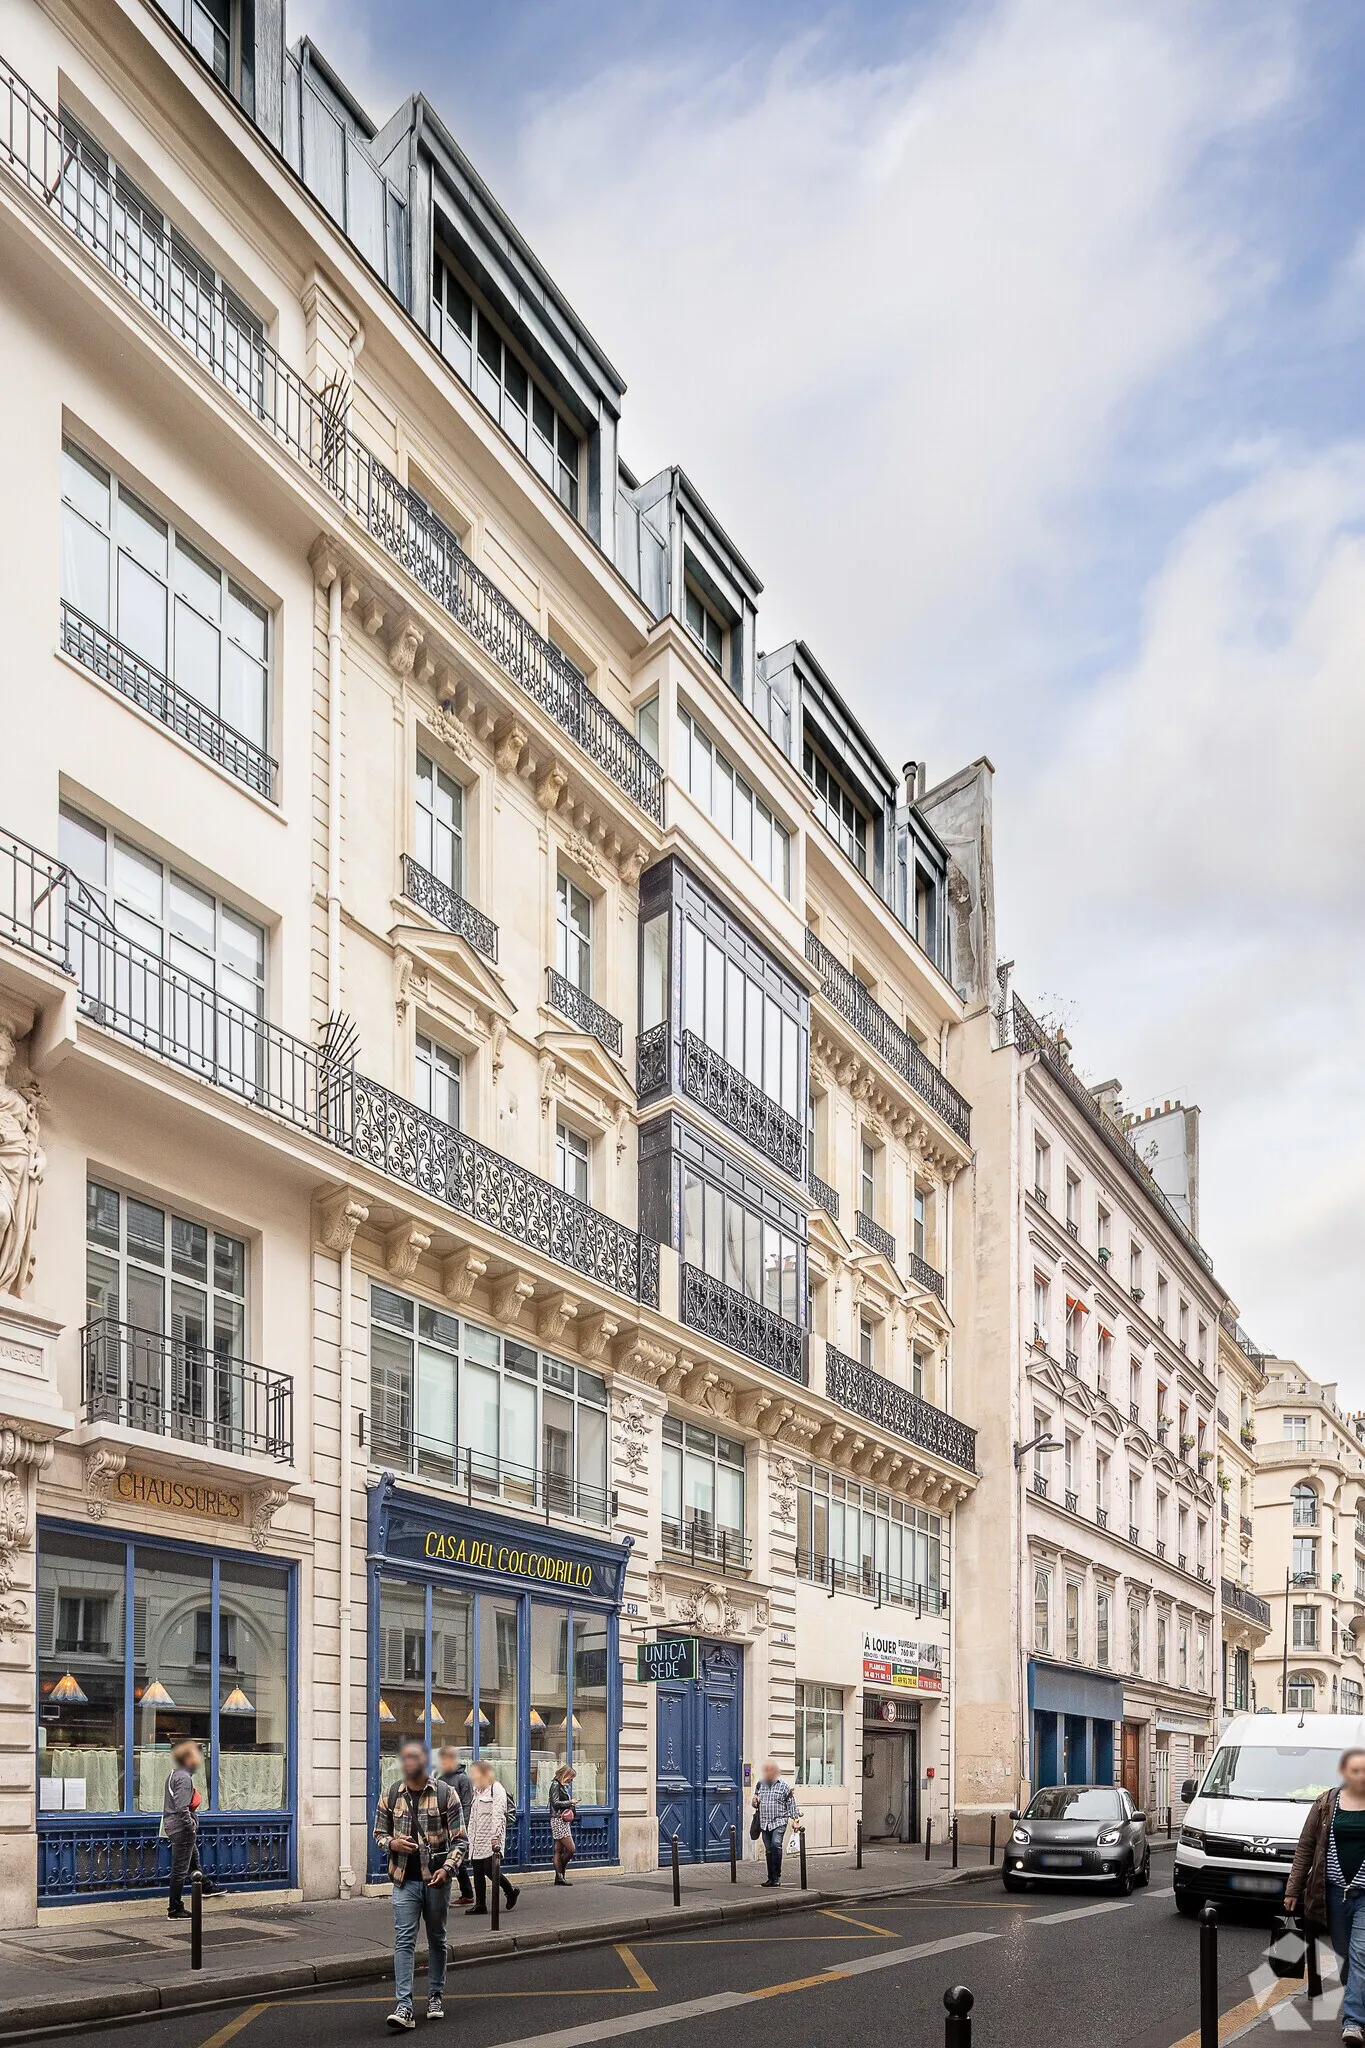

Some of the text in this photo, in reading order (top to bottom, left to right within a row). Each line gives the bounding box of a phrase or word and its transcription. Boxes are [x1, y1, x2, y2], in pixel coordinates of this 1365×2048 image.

[117, 1472, 240, 1518] CHAUSSURES
[425, 1531, 593, 1587] CASA DEL COCCODRILLO
[644, 1642, 687, 1663] UNICA
[872, 1638, 896, 1654] LOUER
[898, 1640, 917, 1649] BUREAUX
[650, 1660, 680, 1680] SEDE
[1243, 1845, 1277, 1855] MAN
